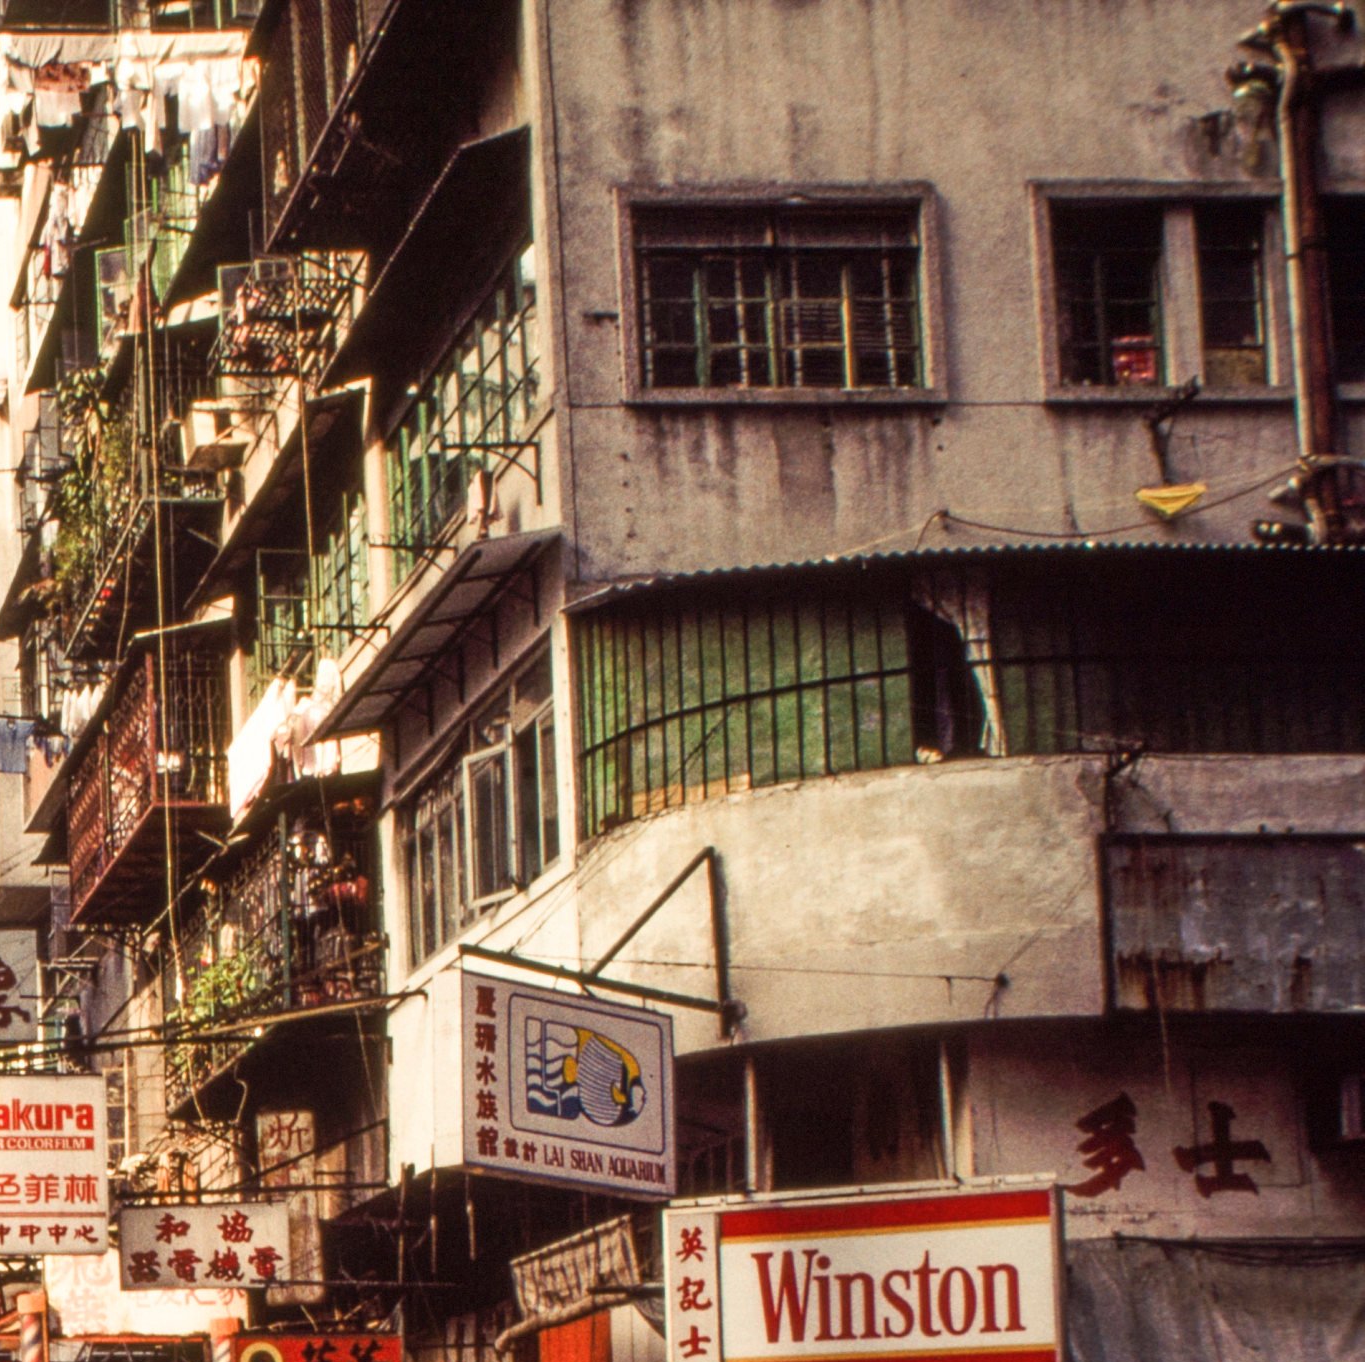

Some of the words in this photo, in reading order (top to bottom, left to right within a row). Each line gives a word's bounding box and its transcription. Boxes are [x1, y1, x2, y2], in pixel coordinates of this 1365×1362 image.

[543, 1144, 565, 1168] LAI
[570, 1148, 604, 1174] SHAN
[608, 1155, 666, 1186] AQUARIUM
[750, 1248, 1027, 1344] Winston
